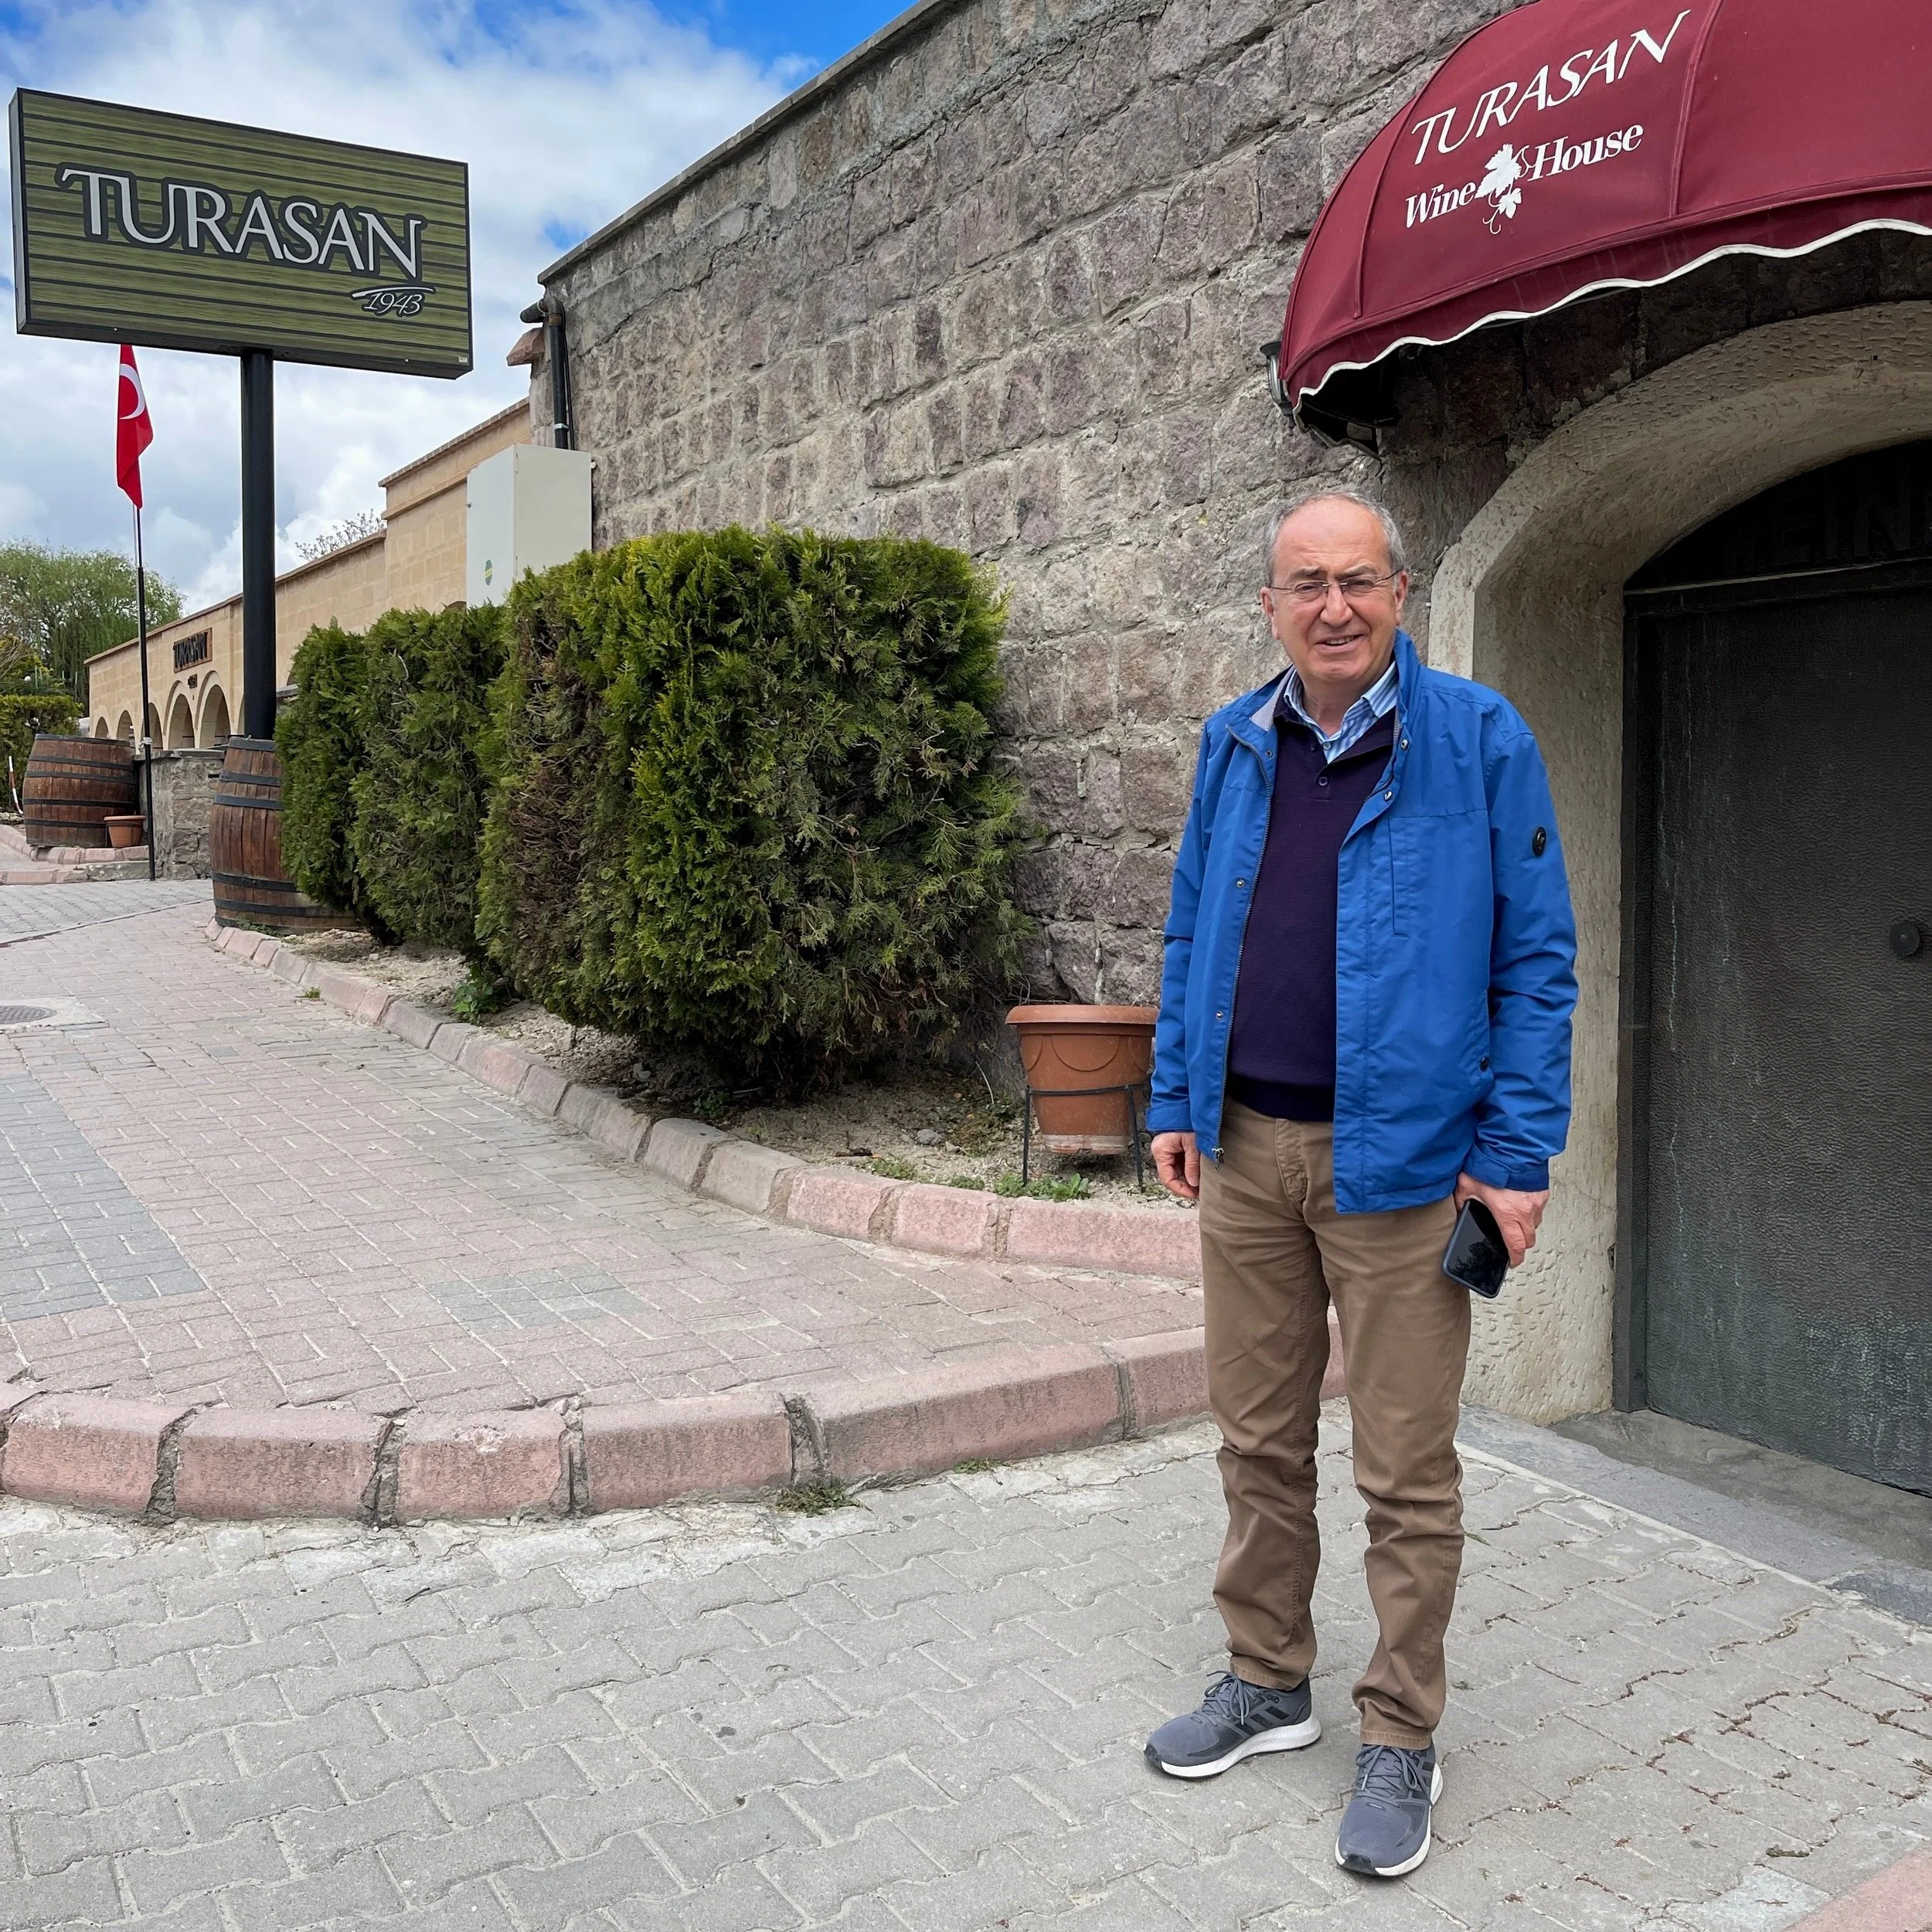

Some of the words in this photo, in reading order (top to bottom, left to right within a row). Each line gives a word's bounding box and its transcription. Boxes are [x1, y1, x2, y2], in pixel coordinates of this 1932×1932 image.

[1411, 9, 1691, 165] TURASAN
[61, 168, 423, 279] TURASAN
[1405, 180, 1477, 229] Wine
[1527, 124, 1645, 182] House
[363, 291, 423, 315] 1943
